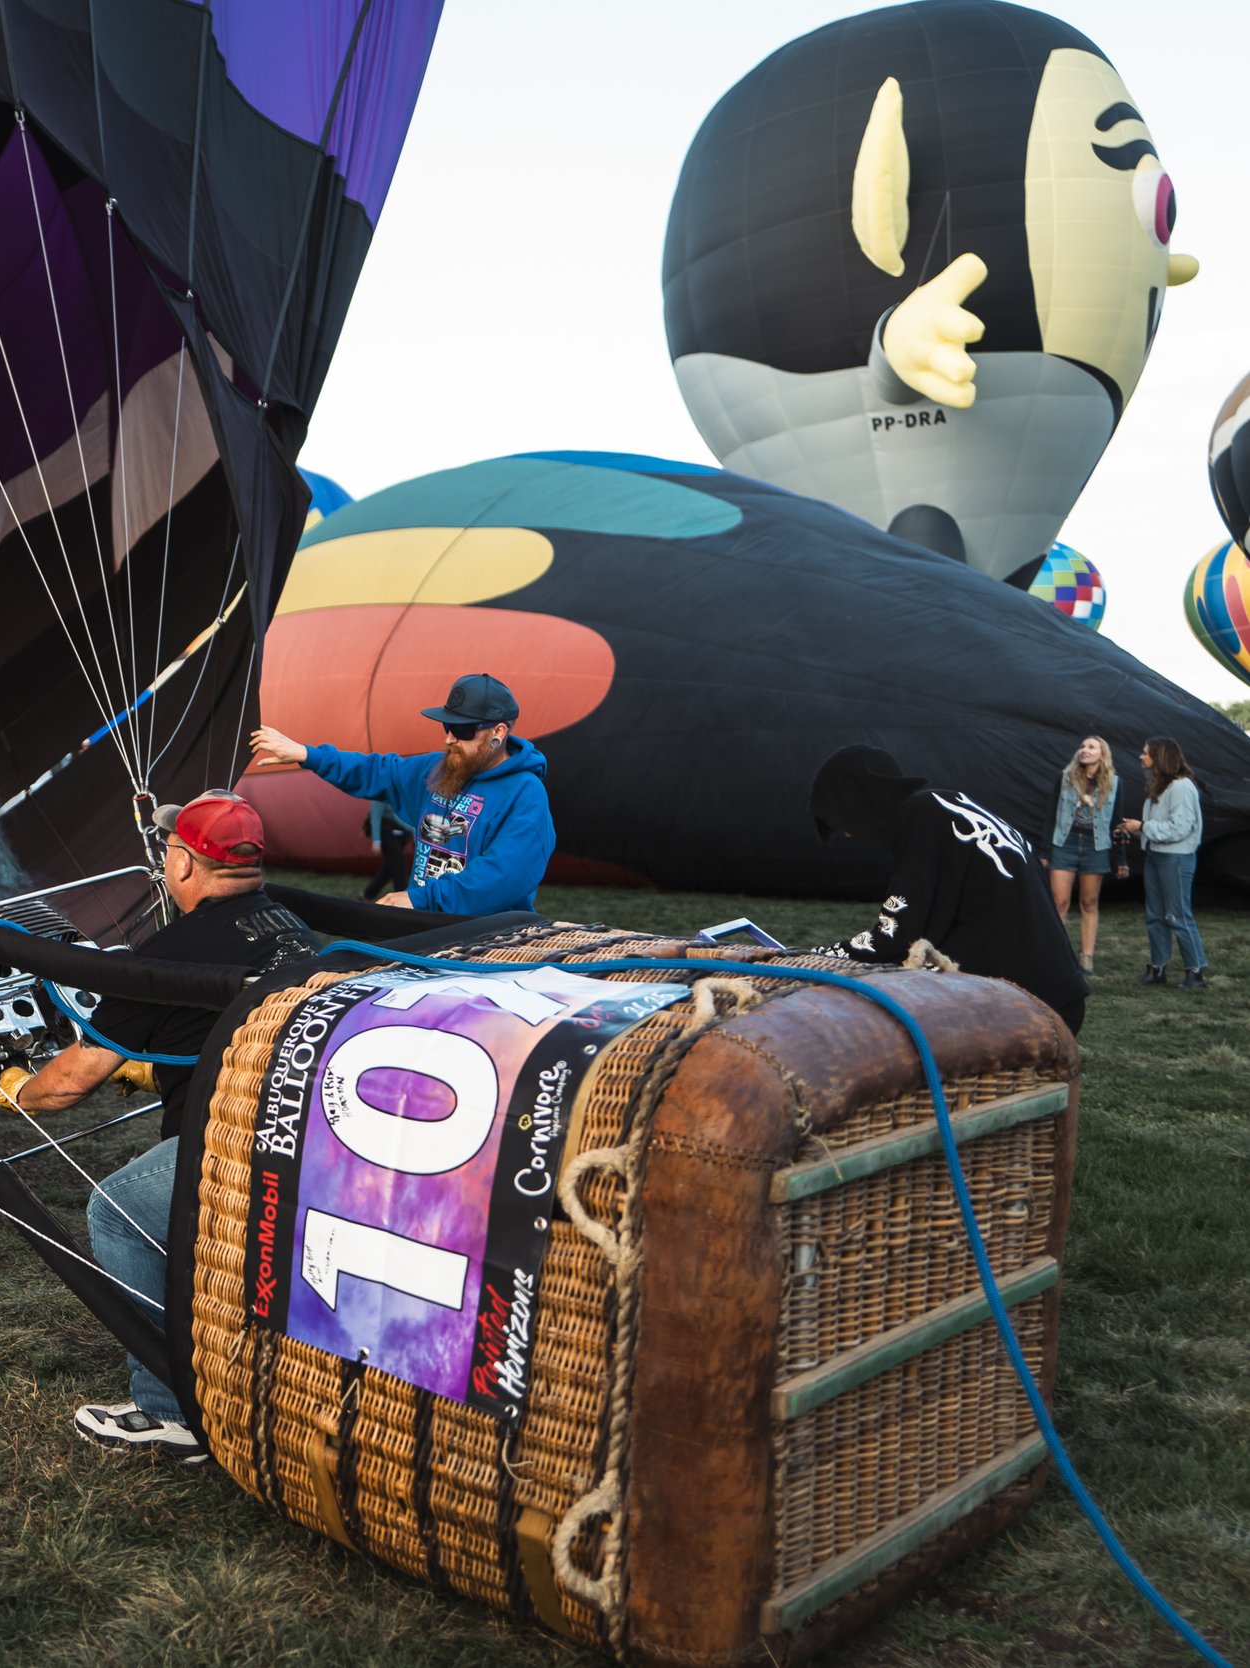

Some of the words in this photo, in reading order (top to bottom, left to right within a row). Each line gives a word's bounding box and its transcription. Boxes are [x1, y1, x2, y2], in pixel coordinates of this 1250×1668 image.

[871, 409, 947, 431] PP-DRA
[256, 1003, 319, 1148] ALBUQUERQUE
[270, 999, 346, 1160] BALLOON
[513, 1065, 560, 1197] Cornivore
[551, 1068, 572, 1104] Company
[255, 1170, 280, 1319] ExxonMobil
[472, 1284, 511, 1399] Painted
[494, 1268, 534, 1399] Horizons
